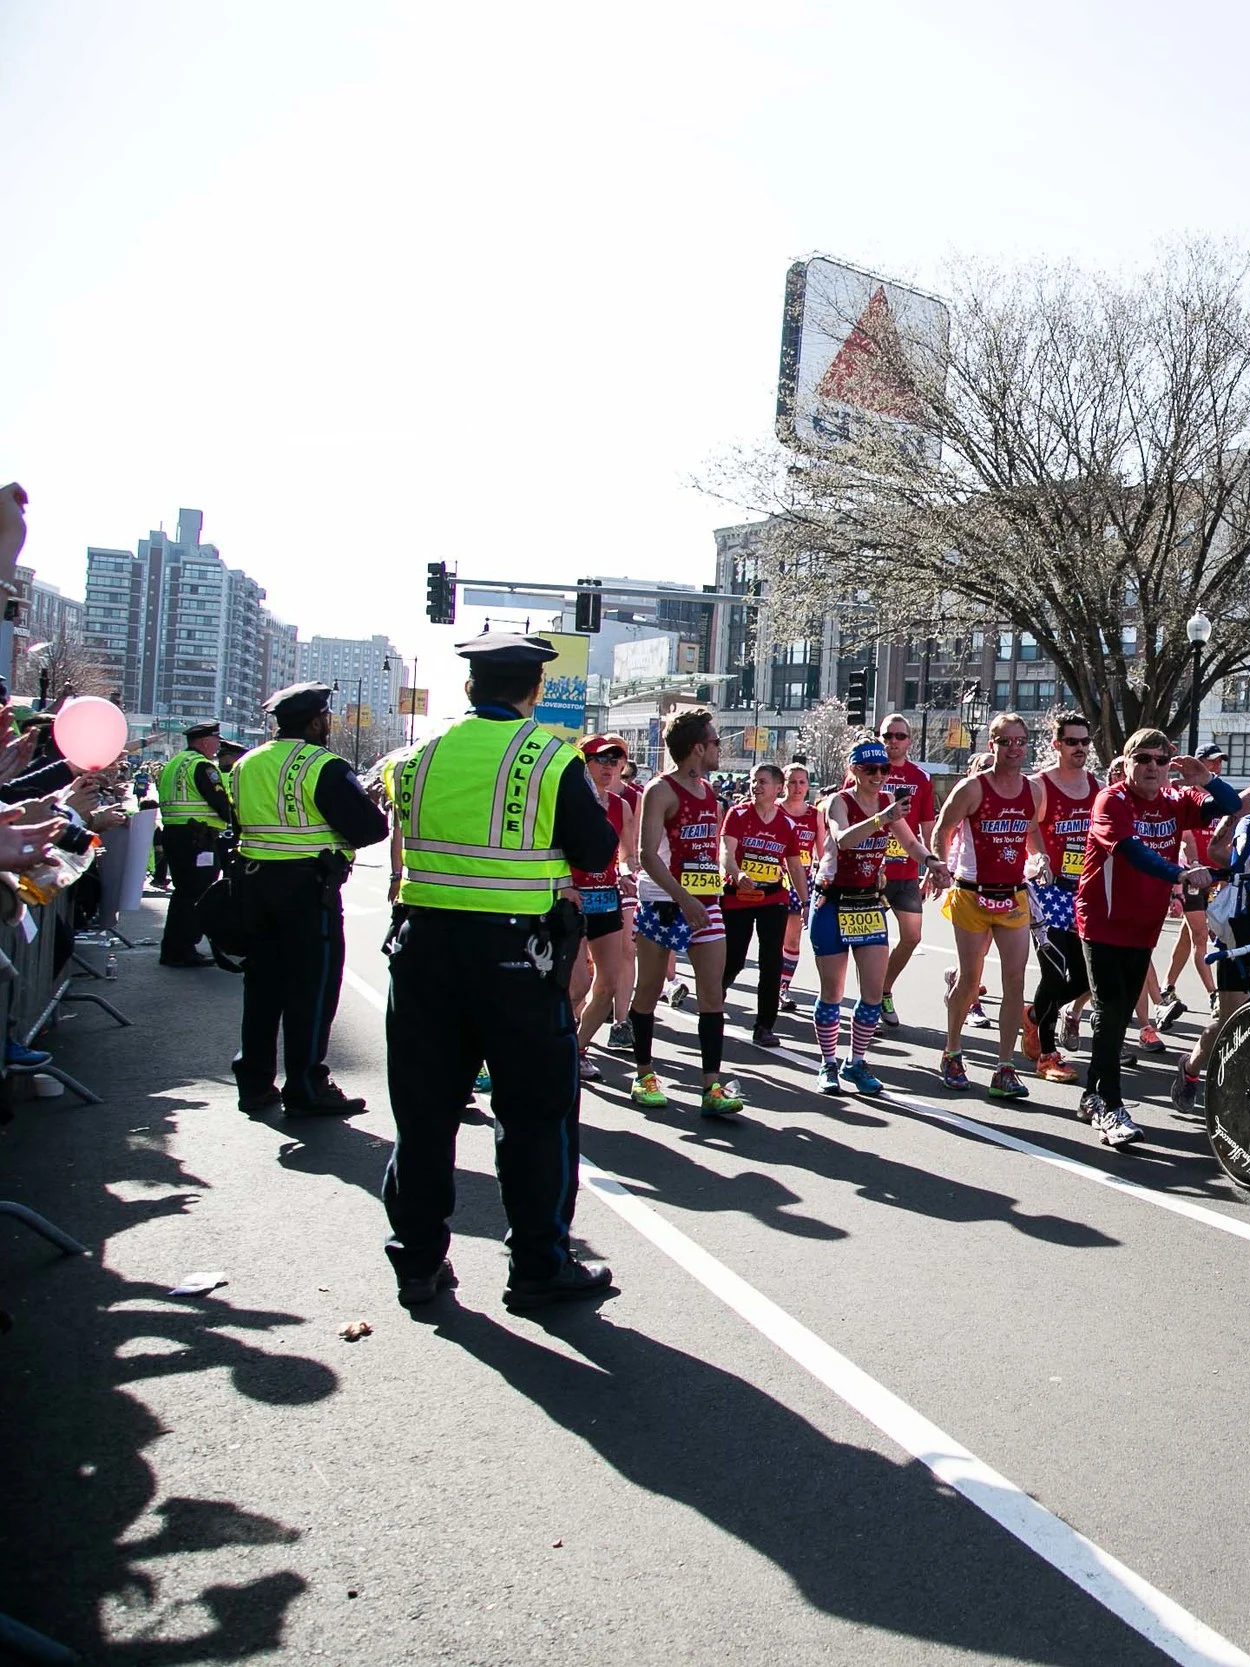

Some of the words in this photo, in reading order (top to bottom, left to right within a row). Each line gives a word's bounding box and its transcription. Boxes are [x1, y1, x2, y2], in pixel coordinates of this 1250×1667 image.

[861, 749, 871, 759] YES
[287, 754, 307, 813] POLICE
[401, 745, 425, 821] STON
[506, 741, 542, 833] POLICE
[679, 823, 709, 840] TEAM
[981, 819, 1011, 833] TEAM
[1055, 820, 1082, 834] TEAM
[741, 837, 765, 849] TEAM
[992, 836, 1003, 844] Yes
[741, 860, 779, 876] 32211
[682, 873, 722, 889] 32548
[839, 912, 881, 927] 33001
